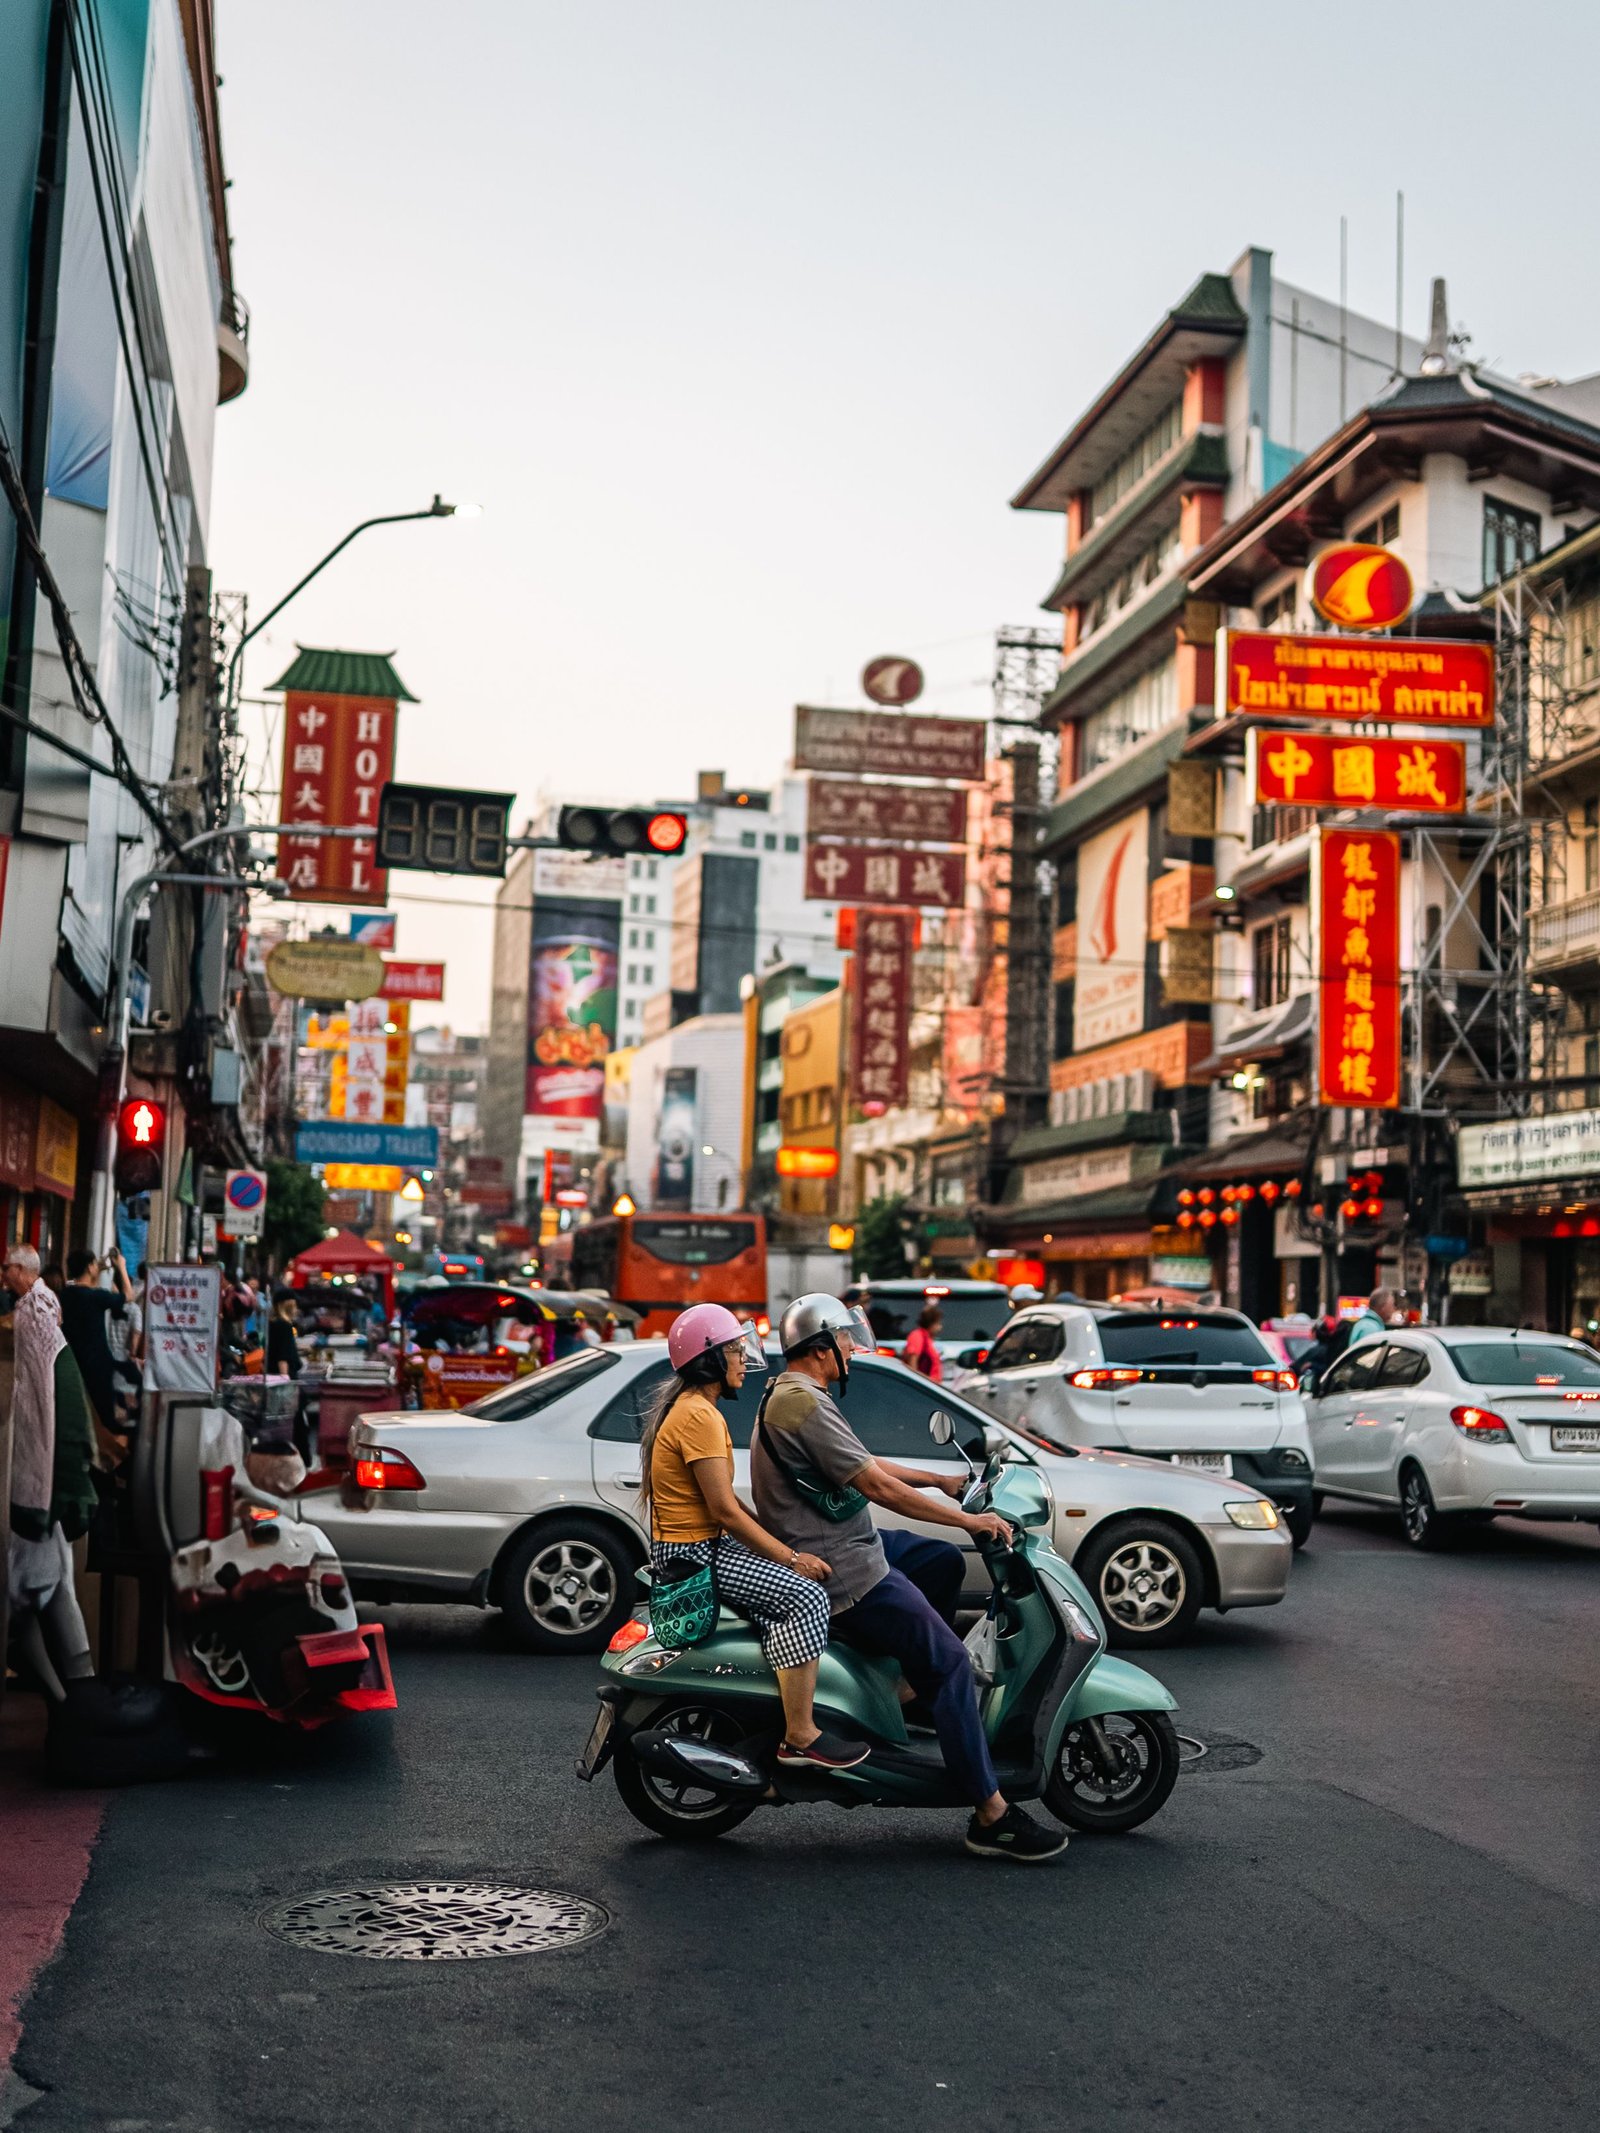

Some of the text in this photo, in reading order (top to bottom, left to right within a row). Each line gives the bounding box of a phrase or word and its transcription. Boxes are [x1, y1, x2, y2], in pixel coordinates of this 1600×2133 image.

[352, 711, 382, 892] HOTEL
[1267, 736, 1447, 807] 中國城
